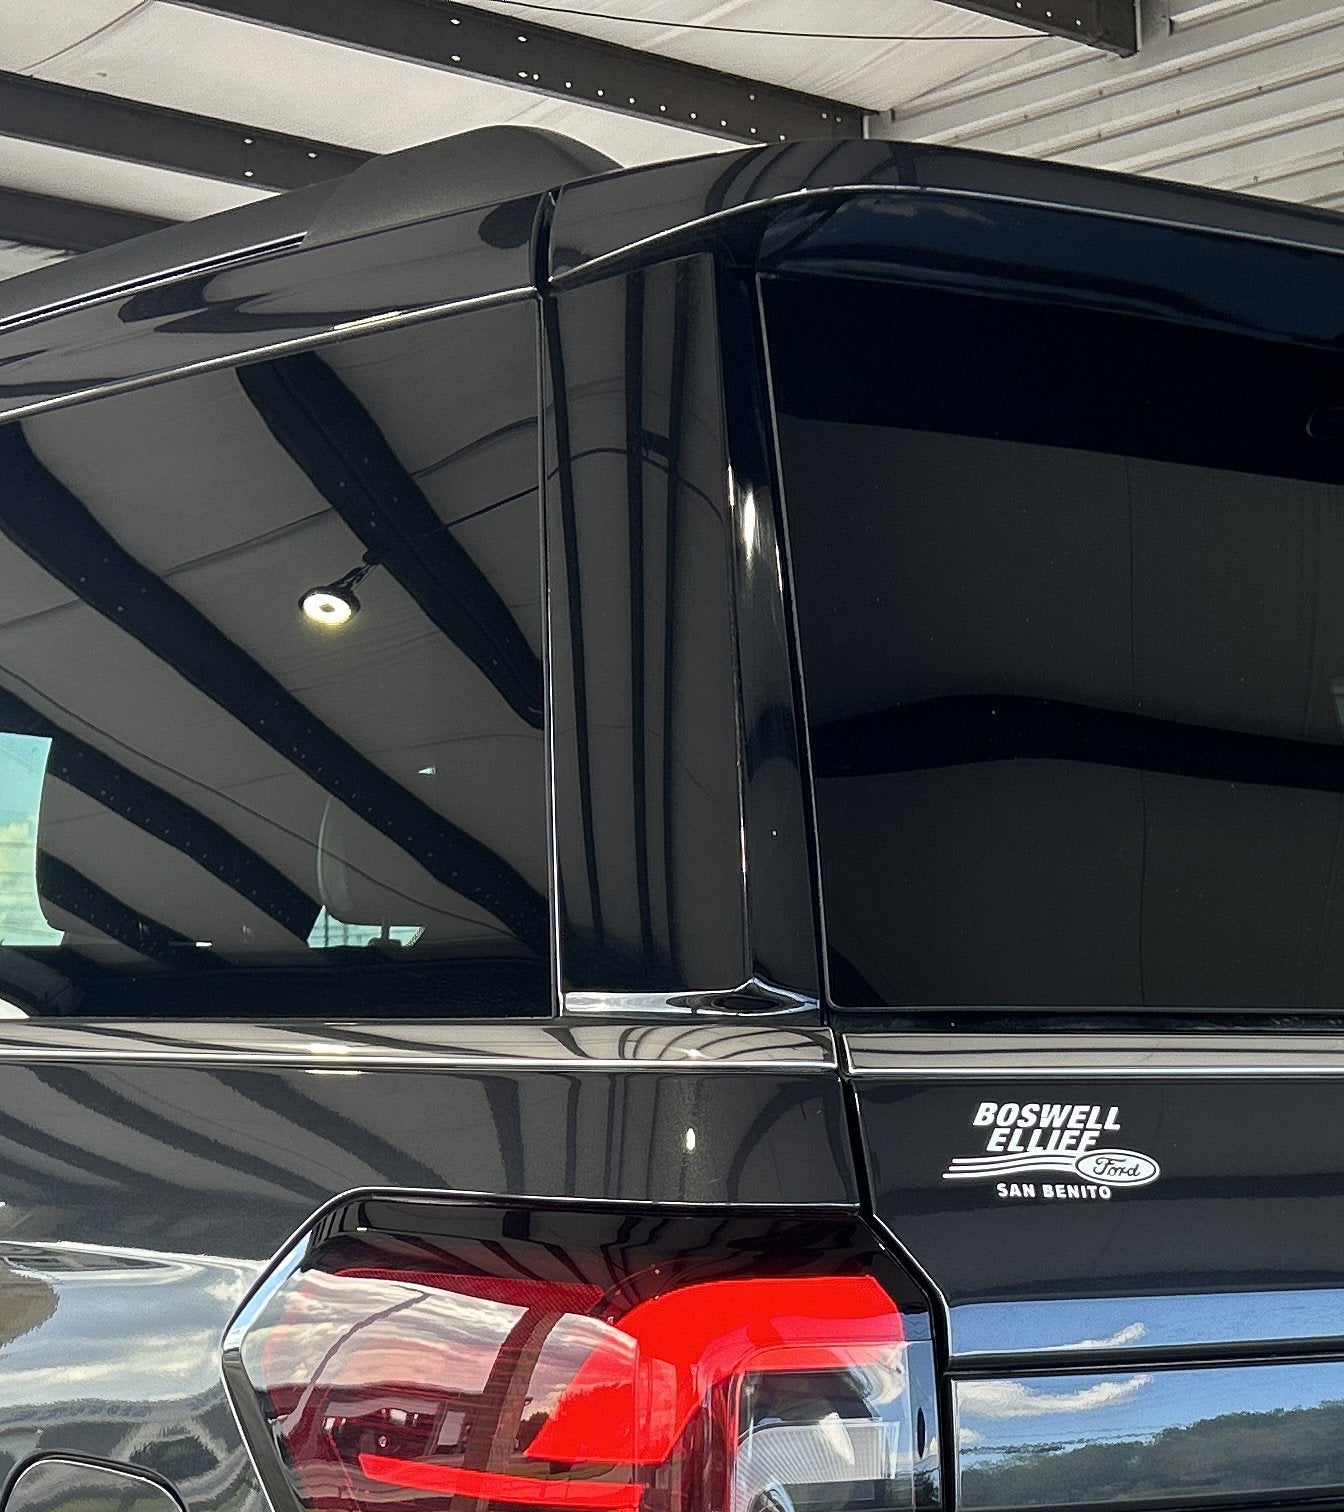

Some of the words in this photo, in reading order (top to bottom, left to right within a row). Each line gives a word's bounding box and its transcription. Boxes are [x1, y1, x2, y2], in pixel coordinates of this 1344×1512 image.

[972, 1102, 1121, 1131] BOSWELL
[986, 1127, 1100, 1152] ELLIFF
[1092, 1156, 1142, 1179] Ford
[996, 1182, 1036, 1199] SAN
[1043, 1184, 1112, 1200] BENITO
